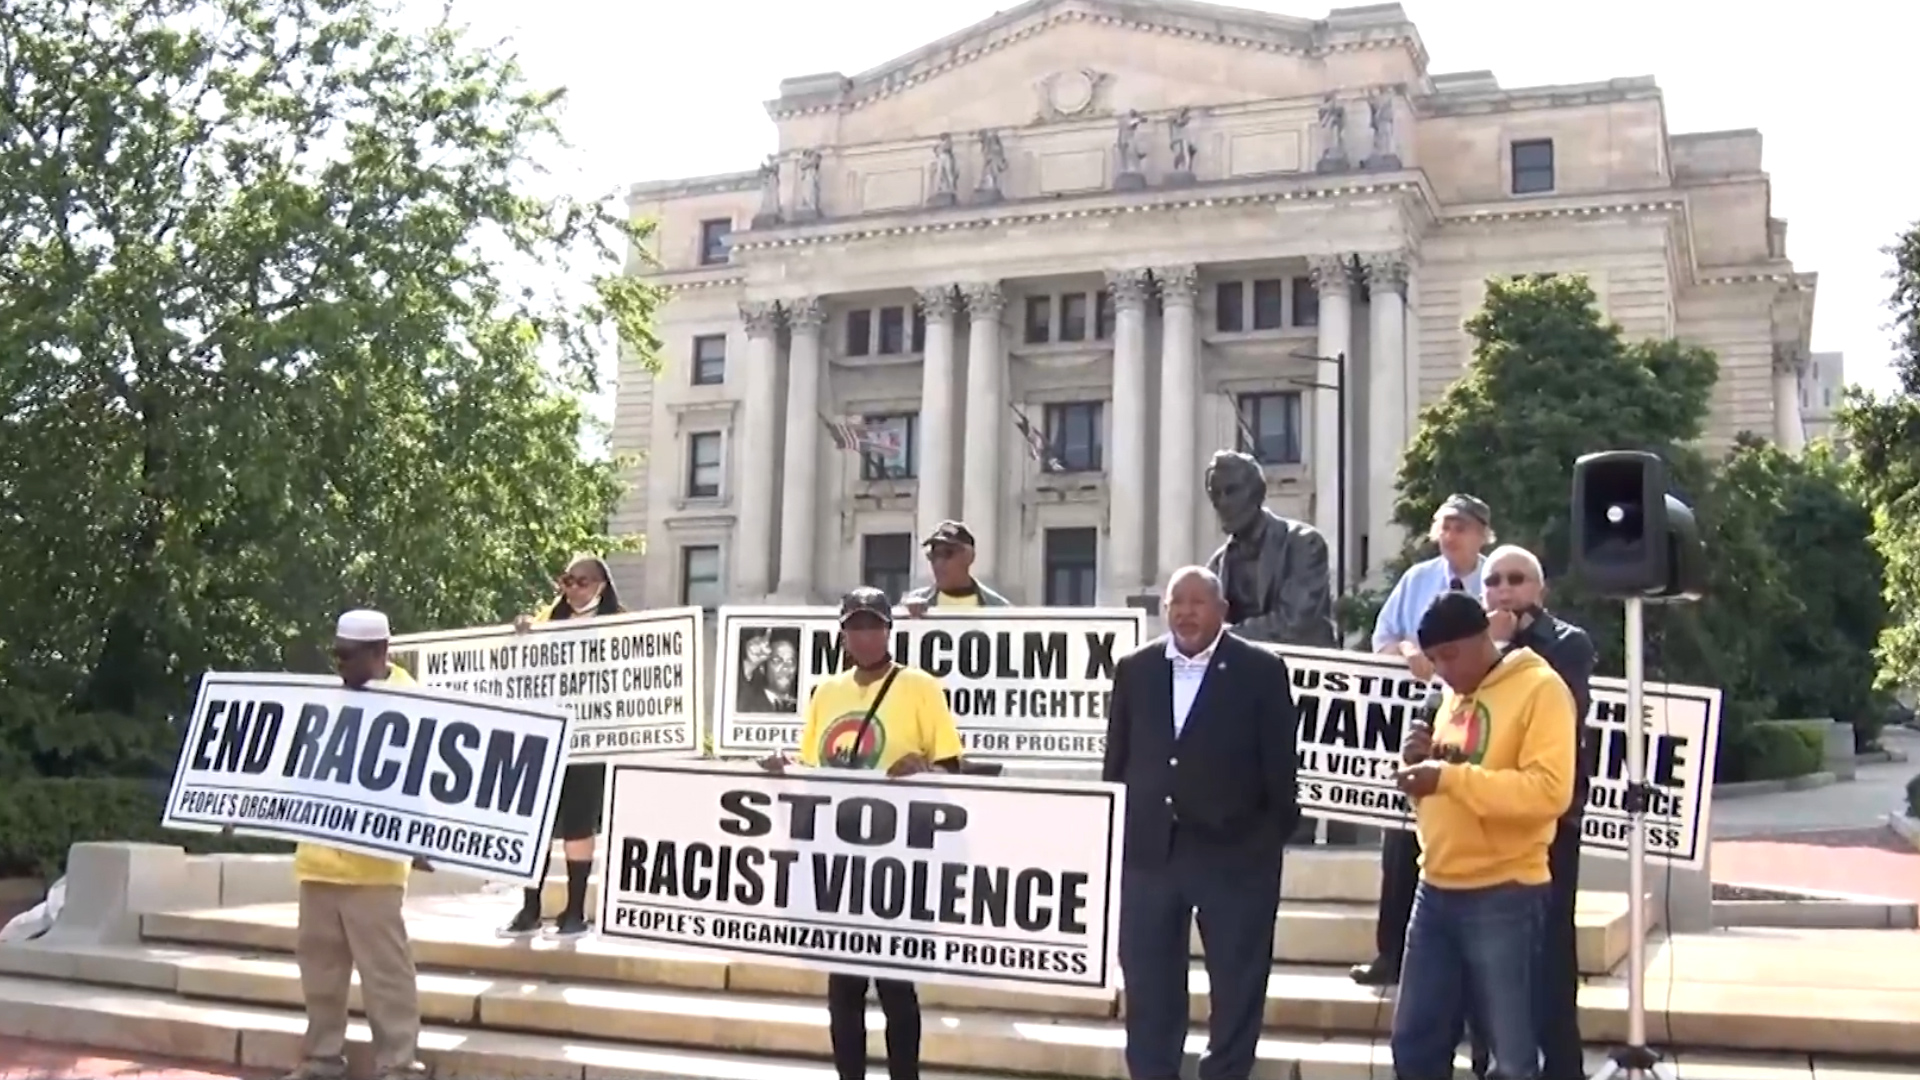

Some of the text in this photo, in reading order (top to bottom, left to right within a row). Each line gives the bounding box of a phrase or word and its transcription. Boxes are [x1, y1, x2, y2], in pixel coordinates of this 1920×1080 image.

[427, 630, 682, 674] WE WILL NOT FORGET THE BOMBING
[1085, 631, 1116, 680] X
[506, 673, 556, 699] STREET
[560, 669, 618, 696] BAPTIST
[622, 663, 683, 692] CHURCH
[1293, 668, 1443, 700] USTIC
[616, 695, 683, 718] RUDOLPH
[596, 727, 685, 748] PROGRESS
[733, 727, 802, 744] PEOPLE
[972, 733, 1009, 750] FOR
[1016, 734, 1107, 753] PROGRES
[191, 700, 549, 817] END RACISM
[179, 790, 525, 864] PEOPLE'S ORGANIZATION FOR PROGRESS
[719, 789, 968, 849] STOP
[619, 836, 1088, 934] RACIST VIOLENCE
[616, 907, 1088, 975] PEOPLE'S ORGANIZATION FOR PROGRESS
